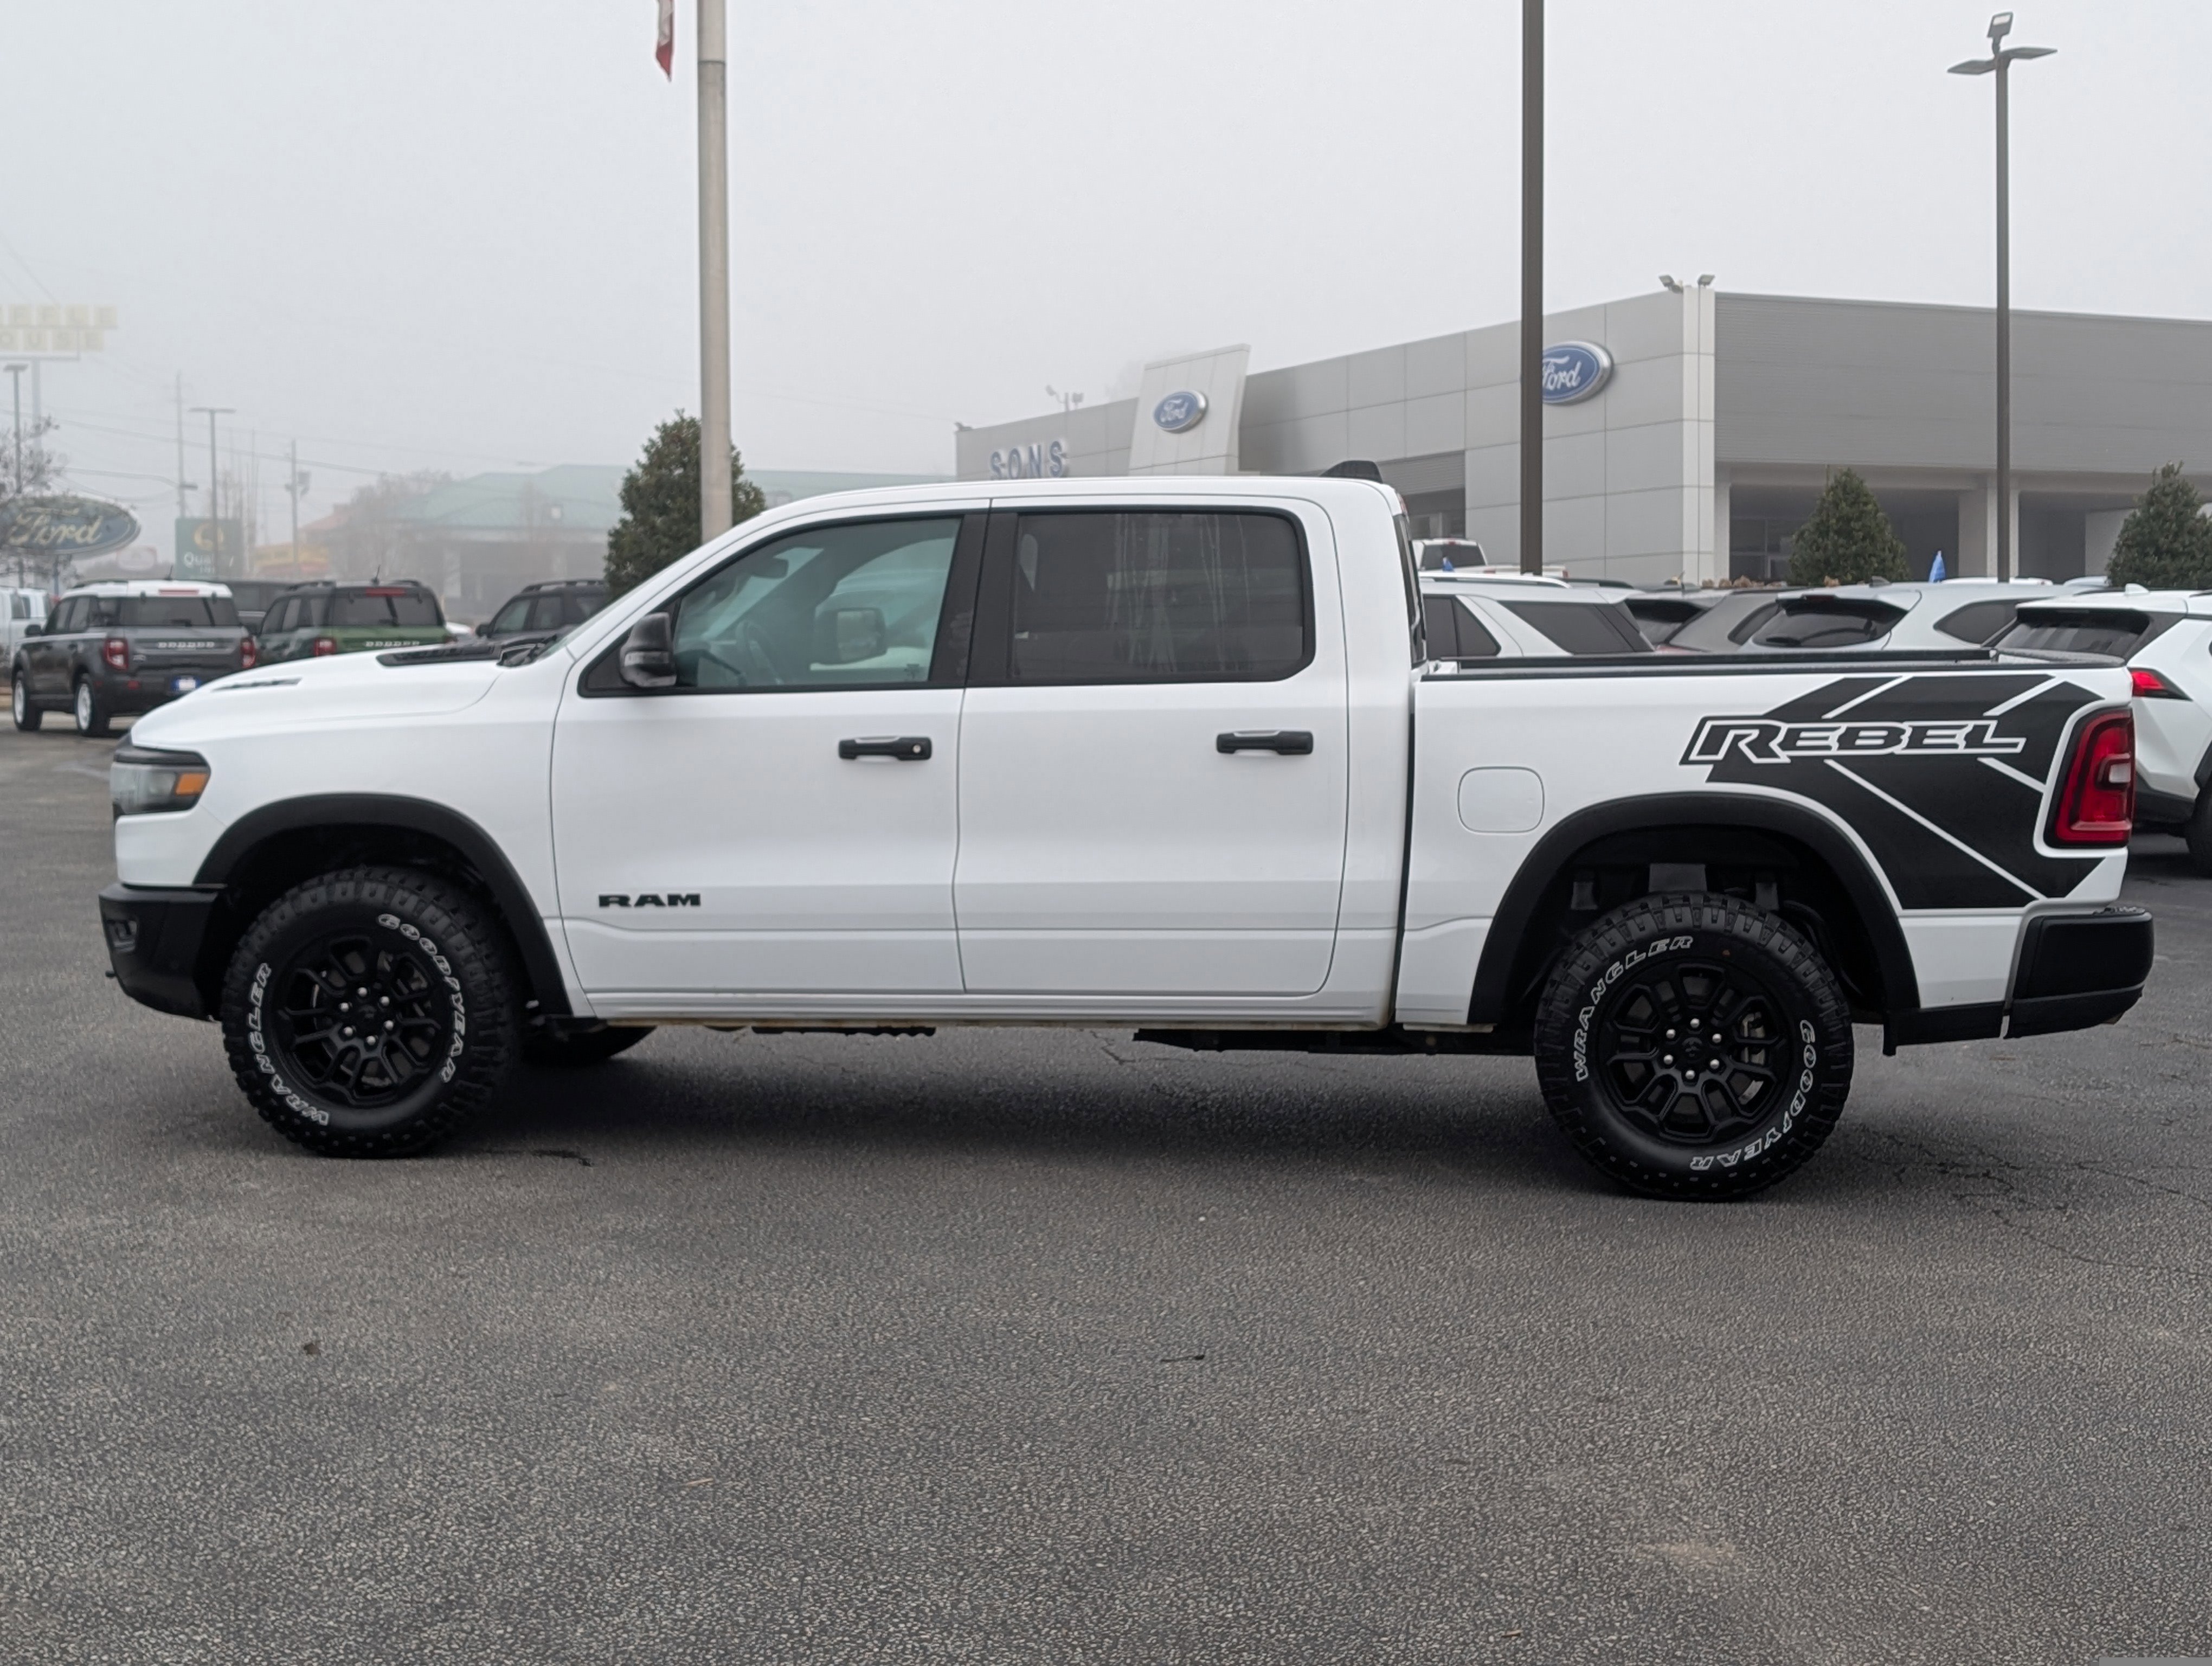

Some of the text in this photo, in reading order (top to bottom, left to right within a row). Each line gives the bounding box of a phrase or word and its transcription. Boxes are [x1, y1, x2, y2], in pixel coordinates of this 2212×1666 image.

[990, 440, 1063, 480] SONS
[8, 507, 103, 545] Ford
[1687, 717, 2027, 764] REBEL
[598, 893, 701, 908] RAM
[247, 962, 329, 1126] WRANGLER
[378, 913, 466, 1082] GOODYEAR
[1573, 935, 1694, 1082] WRANGLER
[1689, 1019, 1817, 1171] GOODYEAR
